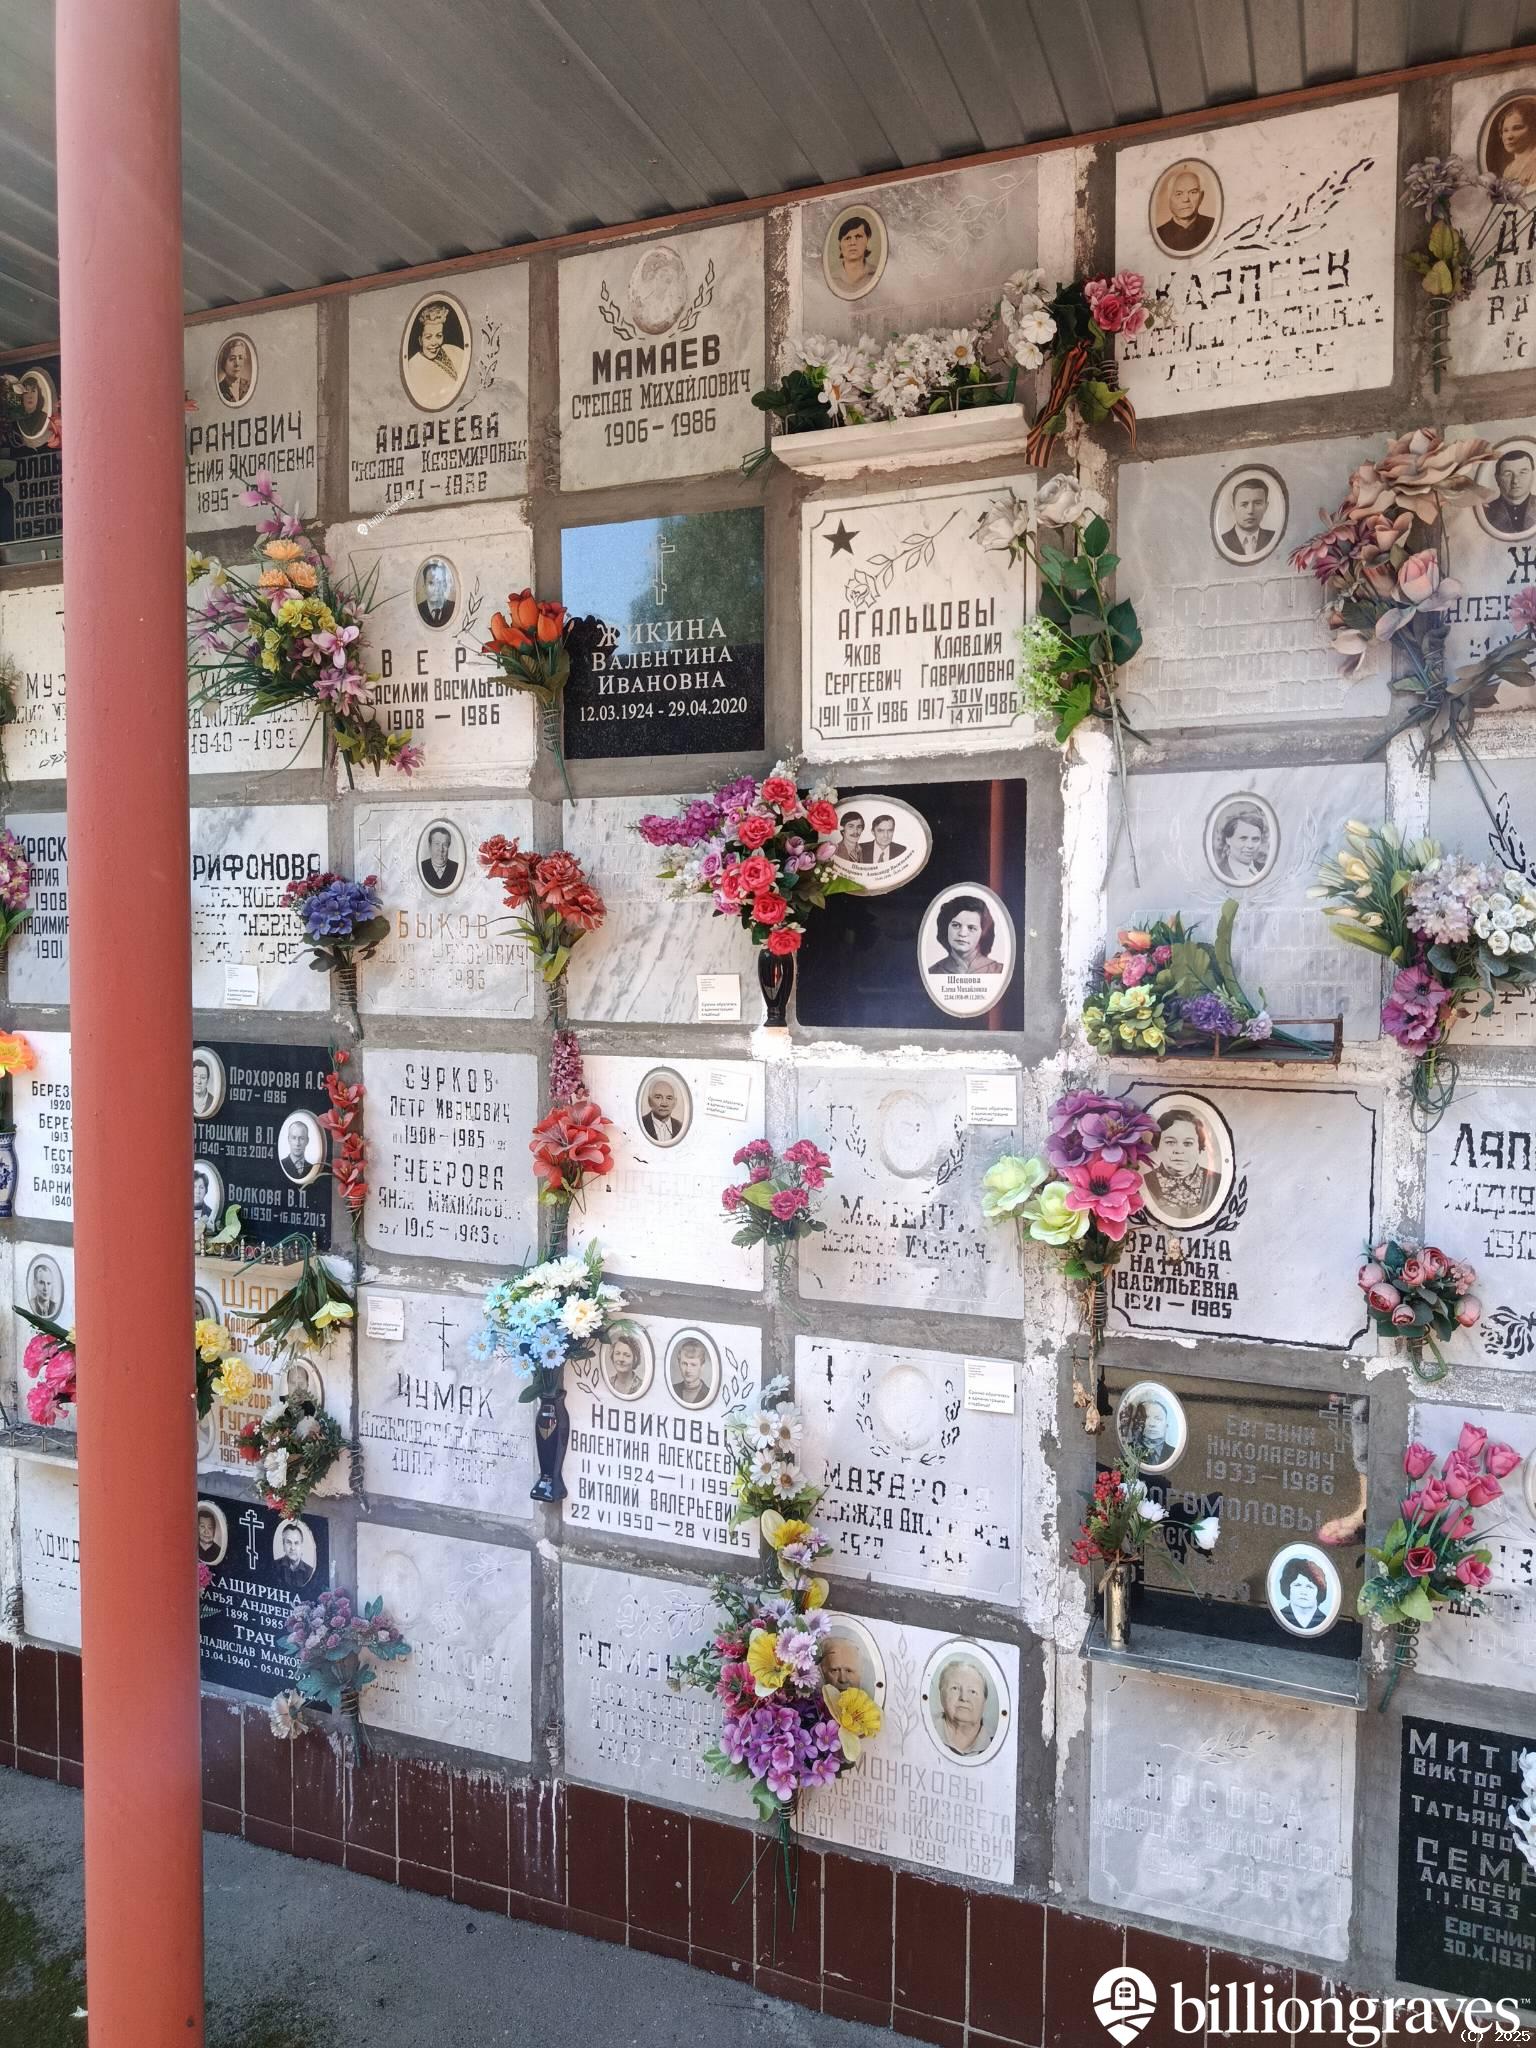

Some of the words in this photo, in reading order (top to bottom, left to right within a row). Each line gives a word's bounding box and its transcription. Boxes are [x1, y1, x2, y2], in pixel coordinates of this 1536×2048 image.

[592, 334, 720, 385] МАМАЕВ
[572, 388, 632, 420] СТЕПАН
[640, 368, 751, 409] МИХАЙЛОВИЧ
[186, 411, 301, 455] РАНОВИЧ
[376, 412, 499, 454] АНДРЕЕВА
[604, 418, 648, 447] 1906
[671, 407, 716, 437] 1986
[188, 458, 224, 485] ЕНИЯ
[19, 480, 62, 500] ВАЛЕ
[597, 617, 727, 648] ЖИКИНА
[838, 597, 995, 640] АГАЛЬЦОВЫ
[591, 645, 734, 672] ВАЛЕНТИНА
[844, 643, 881, 667] ЯКОВ
[934, 632, 1002, 660] КЛАВДИЯ
[598, 671, 727, 696] ИВАНОВНА
[825, 668, 902, 696] СЕРГЕЕВИЧ
[920, 659, 1015, 688] ГАВРИЛОВНА
[388, 709, 425, 731] 1908
[461, 704, 500, 726] 1986
[580, 702, 653, 722] 12.03.1924
[668, 696, 748, 717] 29.04.2020
[877, 700, 908, 723] 1986
[918, 697, 944, 721] 1917
[985, 691, 1018, 716] 1986
[16, 835, 67, 862] КРАСК
[27, 867, 59, 887] АРИЯ
[193, 853, 320, 881] РИФОНОВА
[35, 892, 67, 911] 1908
[398, 910, 488, 939] БЫКОВ
[32, 1081, 70, 1098] БЕРЕЗ
[229, 1066, 299, 1089] ПРОХОРОВА
[405, 1063, 494, 1093] СУРКОВ
[229, 1088, 252, 1102] 1907
[263, 1091, 287, 1104] 1986
[390, 1096, 425, 1118] ПЕТР
[436, 1098, 510, 1124] ИВАНОВИЧ
[39, 1113, 72, 1130] БЕРЕ
[43, 1146, 72, 1162] ТЕСТ
[1450, 1123, 1536, 1170] ЛЯП
[33, 1177, 71, 1195] БАРНИ
[228, 1184, 281, 1207] ВОЛКОВА
[1117, 1271, 1240, 1301] ВАСИЛЬЕВНА
[397, 1373, 494, 1419] ЧУМАК
[571, 1429, 649, 1463] ВАЛЕНТИНА
[1207, 1434, 1335, 1471] НИКОЛАЕВИЧ
[618, 1463, 655, 1484] 1924
[1206, 1458, 1257, 1485] 1933
[1282, 1469, 1335, 1496] 1986
[579, 1477, 640, 1508] ВИТАЛИЙ
[571, 1503, 590, 1520] 22
[618, 1510, 653, 1531] 1950
[675, 1521, 695, 1538] 28
[225, 1607, 249, 1622] 1898
[260, 1616, 284, 1630] 1985
[233, 1624, 276, 1648] ТРАЧ
[1413, 1757, 1502, 1788] ВИКТОР
[1472, 1830, 1514, 1853] 190
[1417, 1836, 1536, 1887] СЕМЕ
[1420, 1866, 1521, 1902] АЛЕКСЕЙ
[1445, 1915, 1536, 1951] ЕВГЕНИЯ
